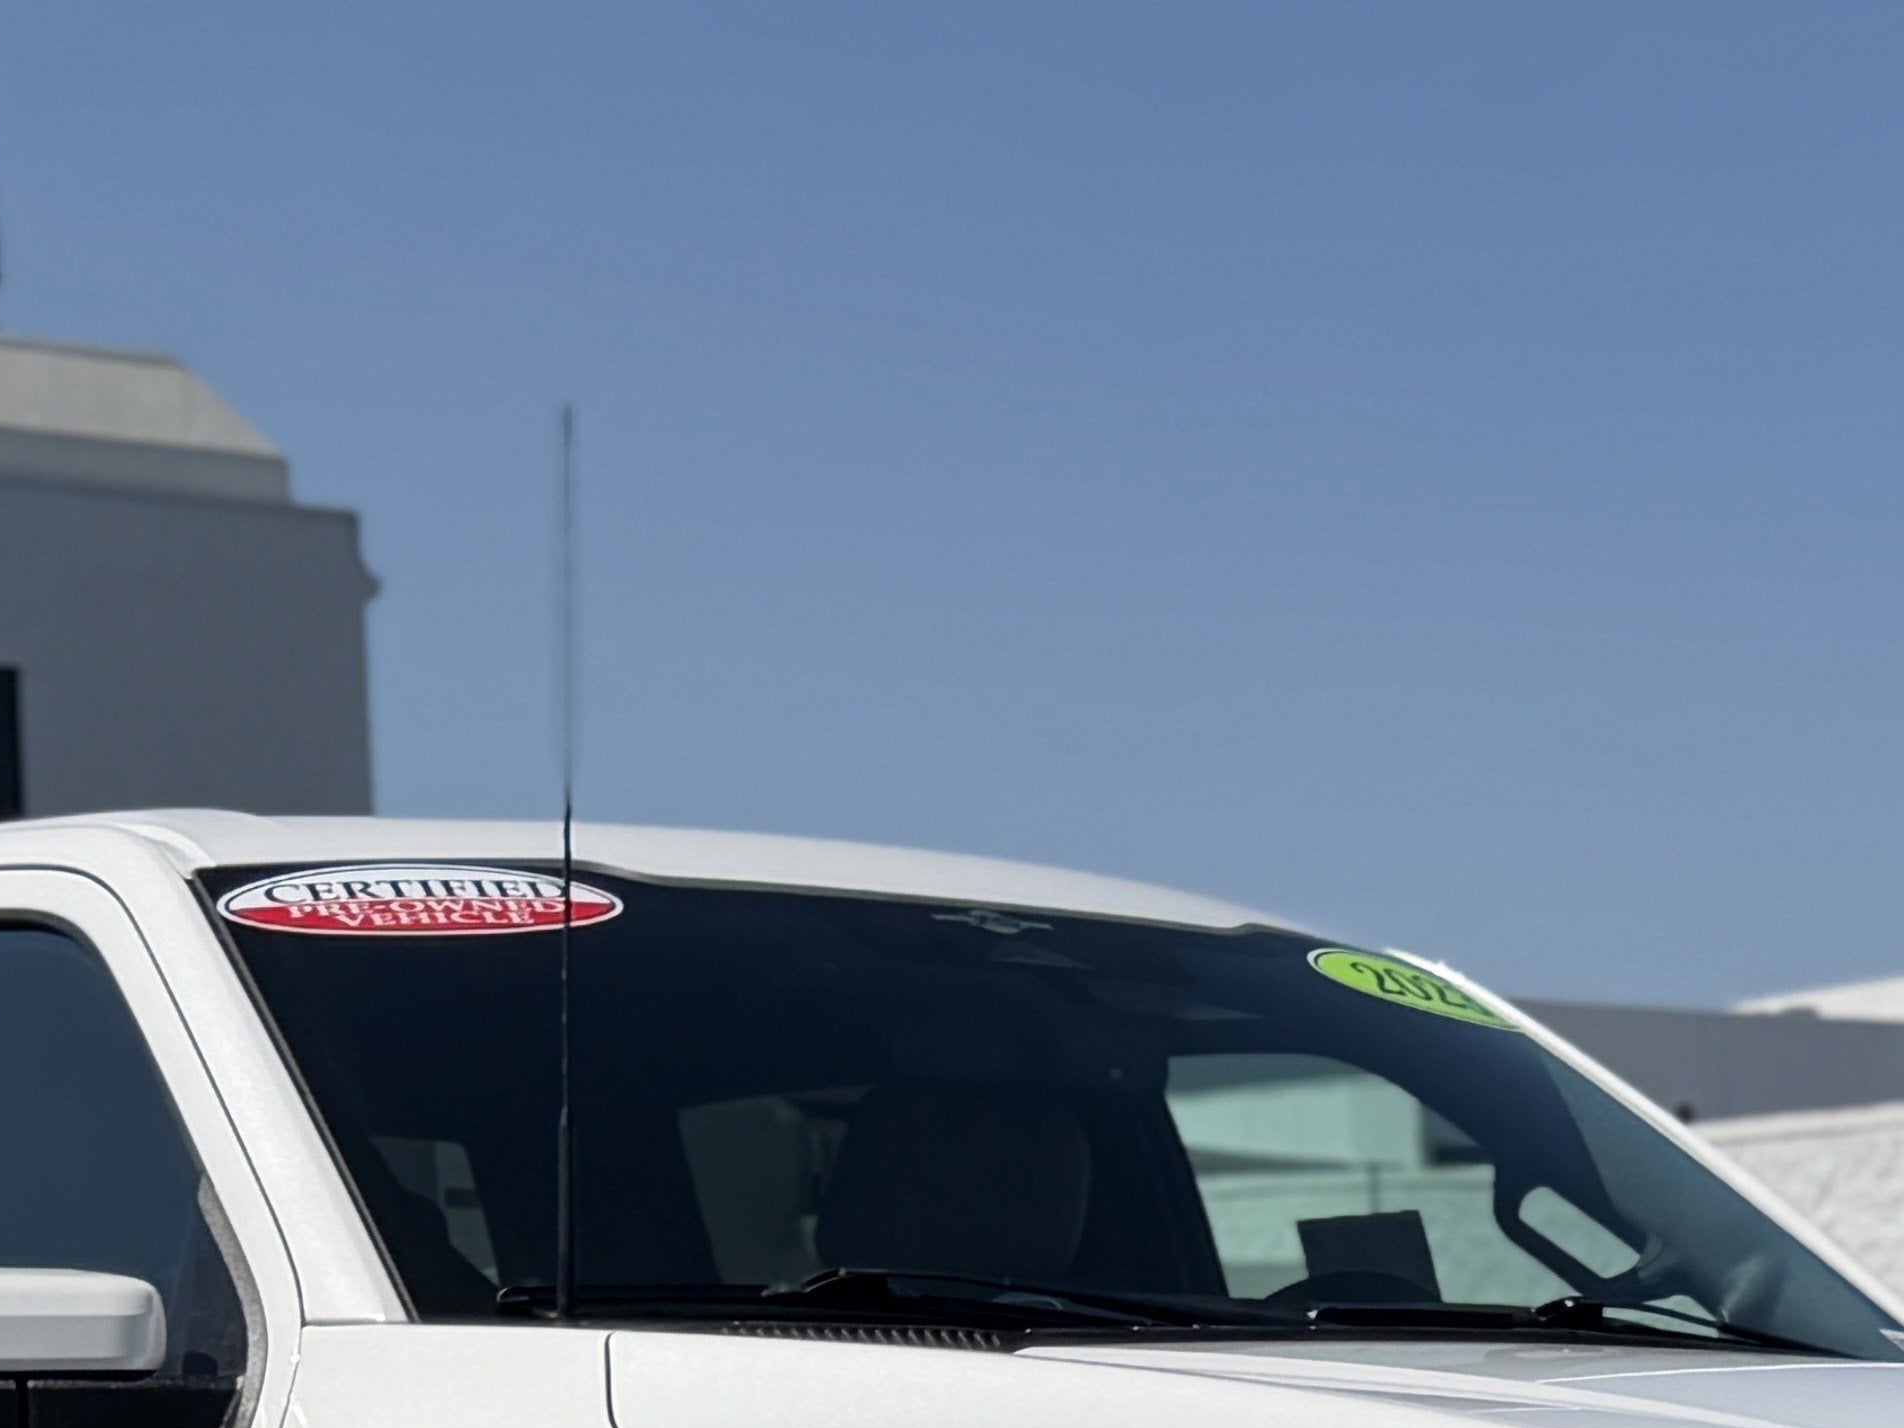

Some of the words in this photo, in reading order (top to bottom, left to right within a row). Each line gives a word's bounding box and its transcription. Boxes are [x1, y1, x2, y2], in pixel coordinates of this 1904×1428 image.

[263, 880, 569, 904] CERTIFIED
[288, 899, 567, 918] PRE-OWNED
[334, 911, 535, 928] VEHICLE
